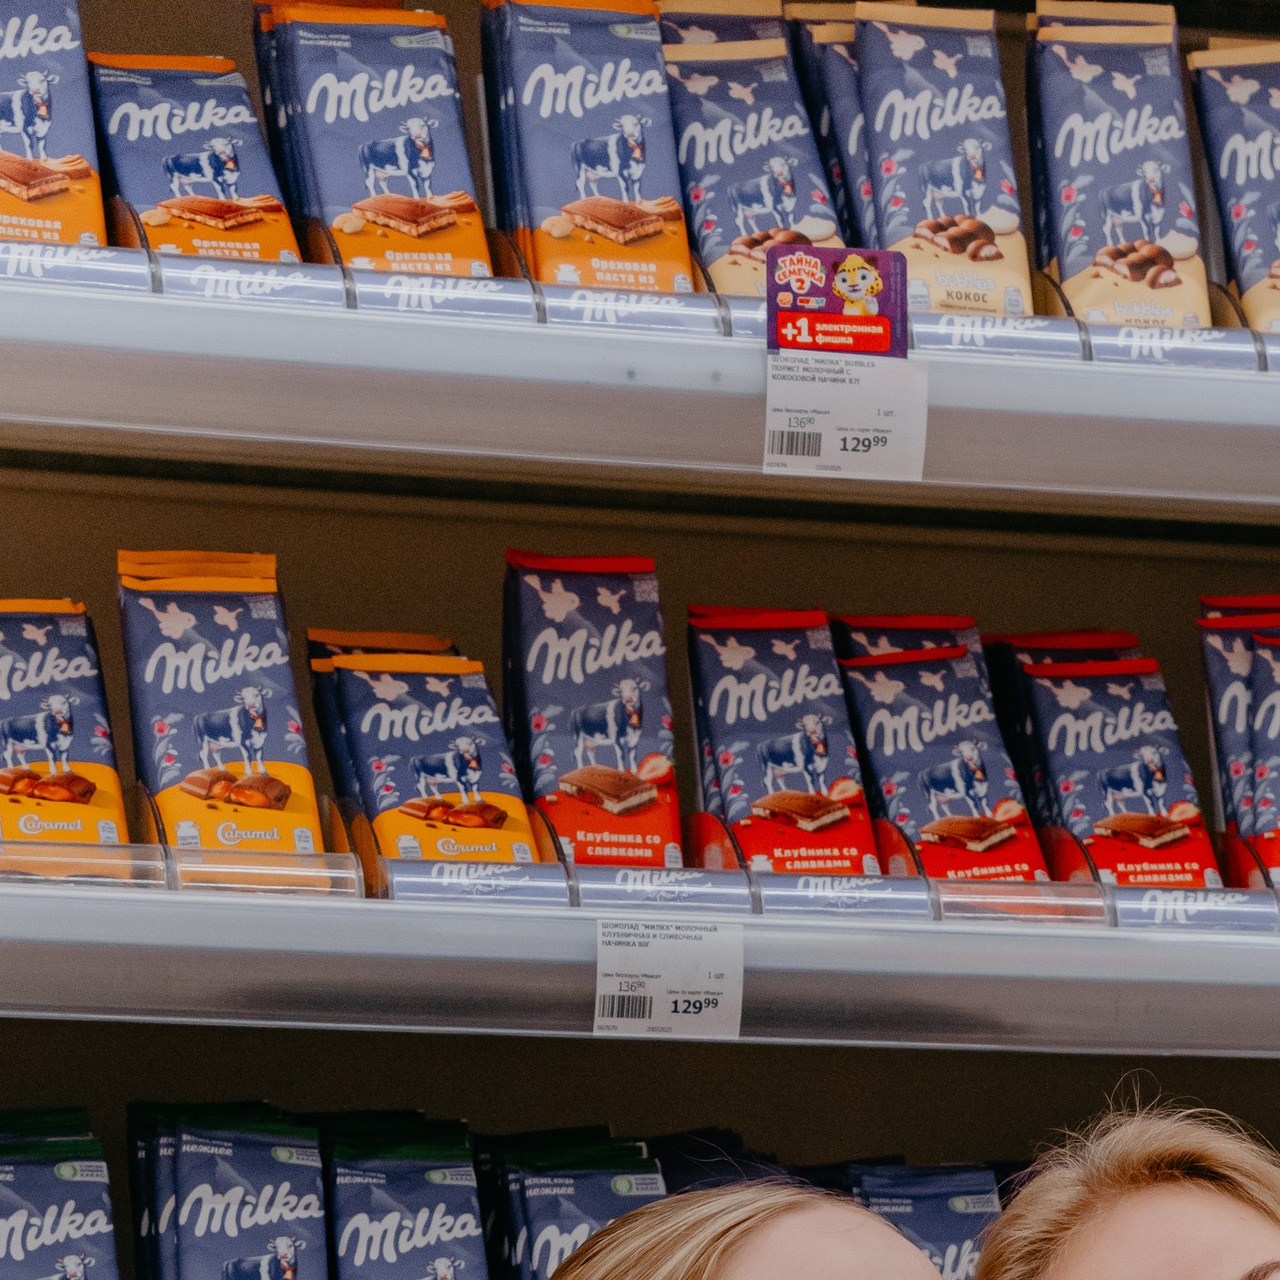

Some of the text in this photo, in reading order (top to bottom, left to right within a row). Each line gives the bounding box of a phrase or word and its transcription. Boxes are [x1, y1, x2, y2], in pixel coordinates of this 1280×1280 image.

[306, 65, 453, 123] Milka
[523, 58, 668, 118] Milka
[109, 99, 257, 141] Milka
[875, 83, 1006, 142] Milka
[679, 107, 811, 169] Milka
[1055, 104, 1185, 167] Milka
[780, 256, 819, 270] ТАЙНА
[190, 265, 311, 298] Milka
[384, 274, 503, 311] Milka
[794, 278, 805, 290] 2
[570, 289, 685, 324] Milka
[781, 317, 813, 343] +1
[815, 323, 883, 333] электронная
[815, 333, 853, 344] фишка
[145, 634, 288, 693] Milka
[527, 620, 665, 684] Milka
[709, 664, 844, 725] Milka
[361, 698, 499, 741] Milka
[866, 694, 995, 756] Milka
[1048, 702, 1177, 756] Milka
[18, 813, 84, 831] Caramel
[216, 822, 280, 845] Caramel
[576, 830, 646, 844] Клубника
[436, 837, 498, 855] Caramel
[587, 845, 653, 857] сливками
[773, 847, 839, 858] Клубника
[786, 857, 851, 869] сливками
[1117, 861, 1181, 873] Клубника
[602, 923, 639, 931] ШОКОЛАД
[675, 925, 718, 933] МОЛОЧНЫЙ
[179, 1182, 324, 1237] Milka
[339, 1203, 482, 1266] Milka
